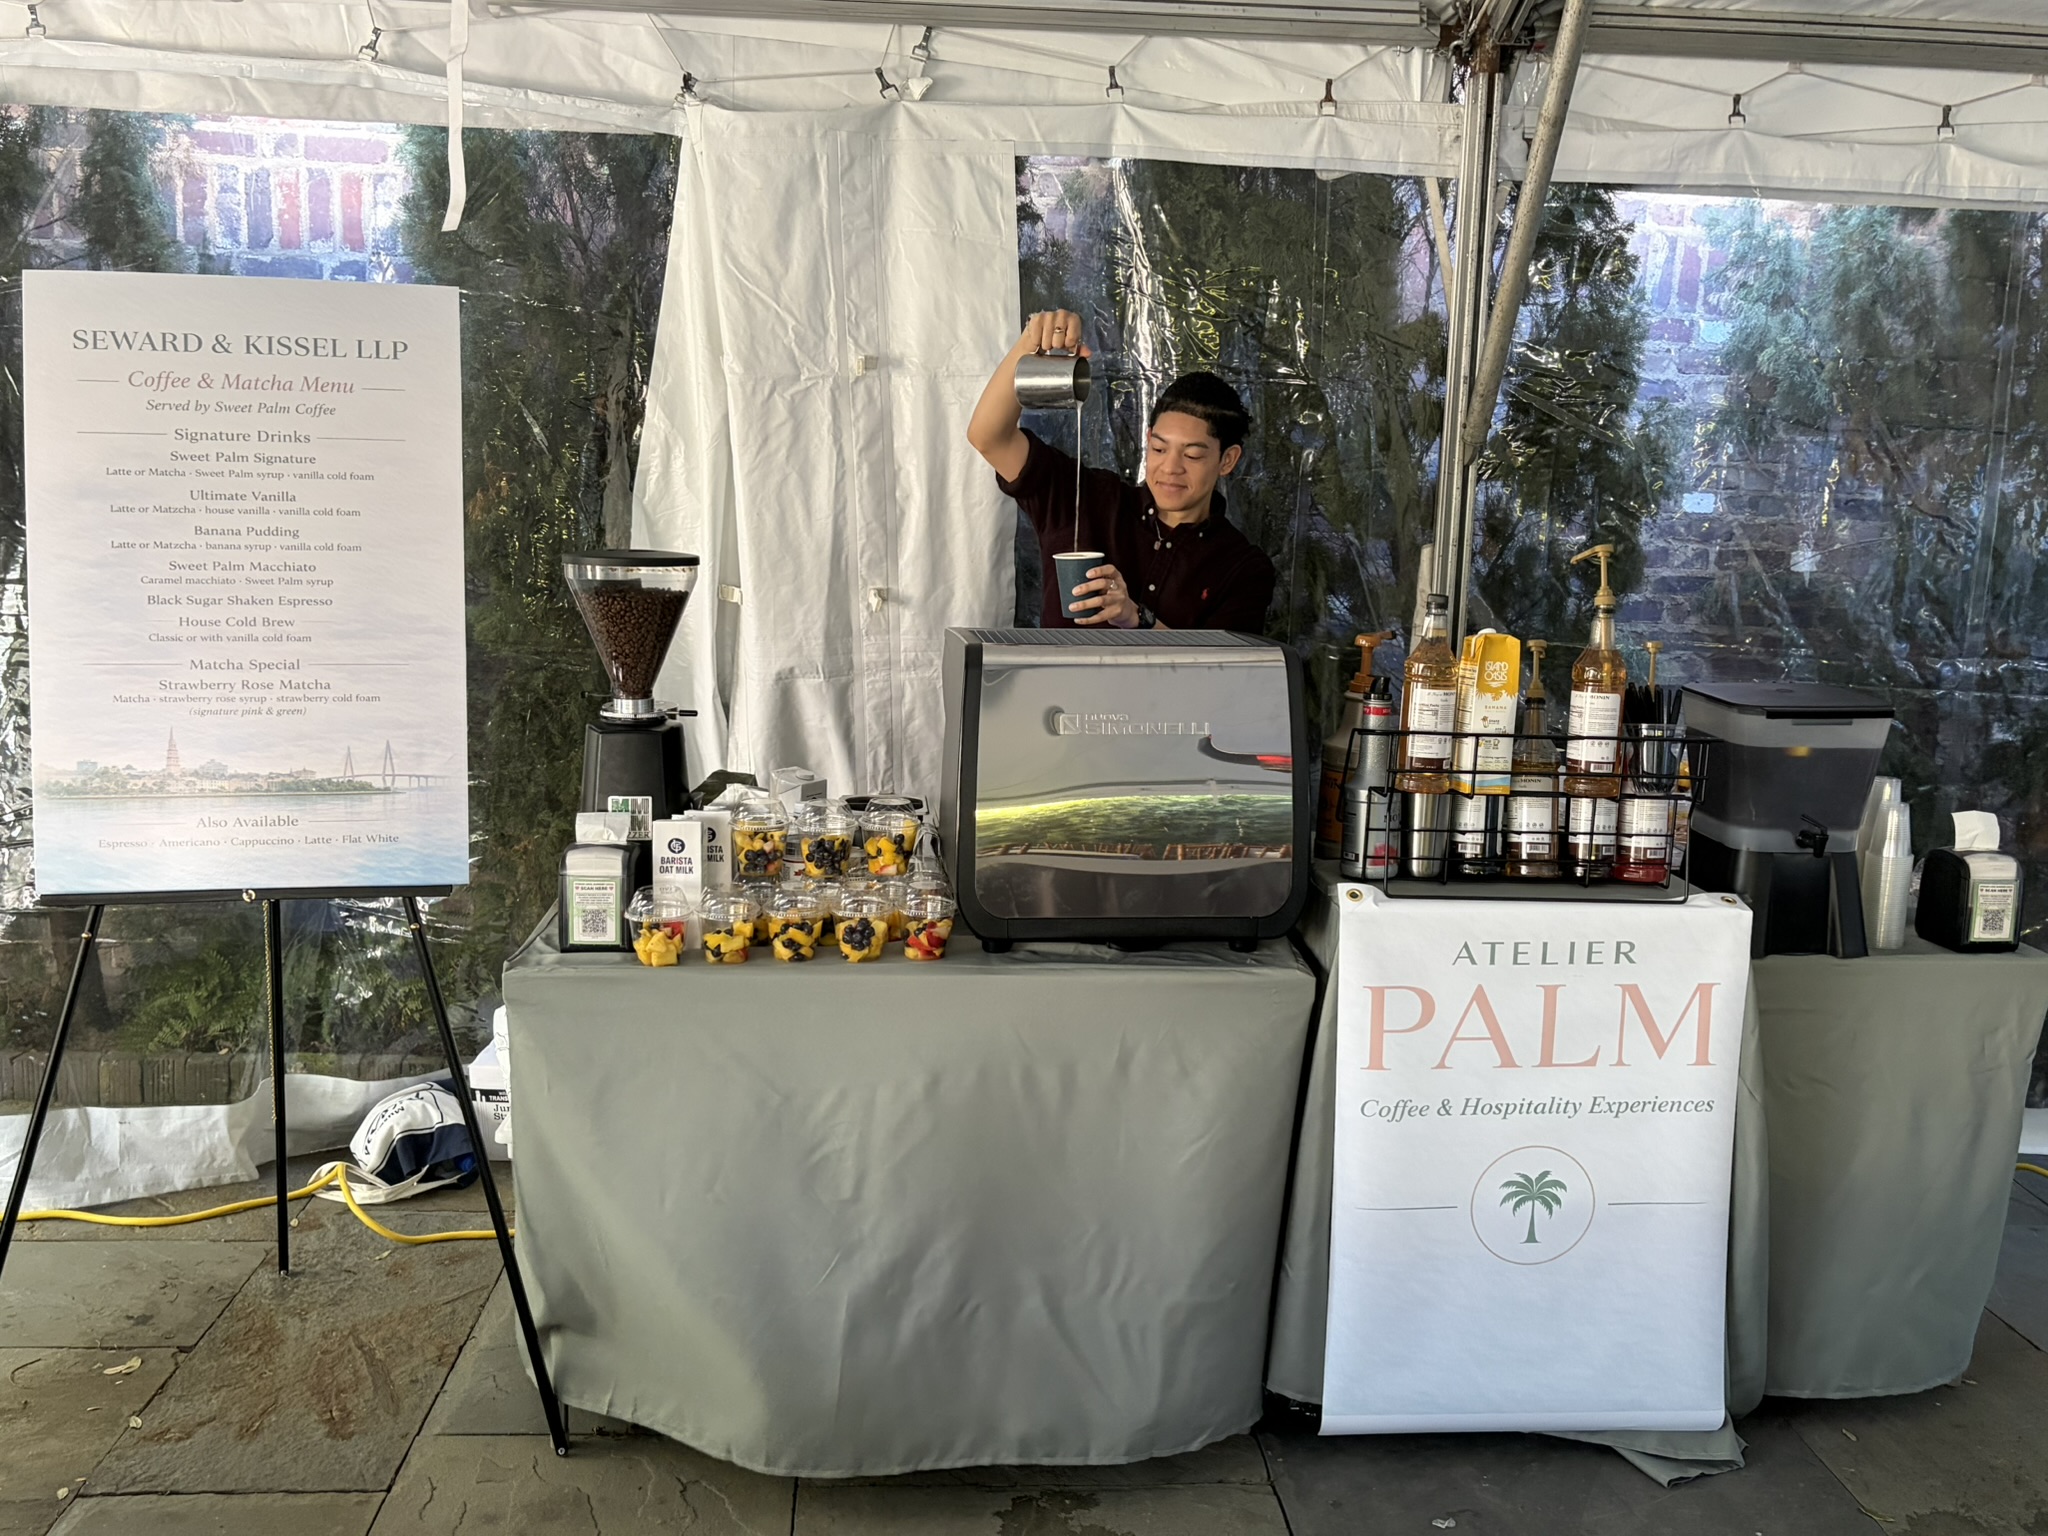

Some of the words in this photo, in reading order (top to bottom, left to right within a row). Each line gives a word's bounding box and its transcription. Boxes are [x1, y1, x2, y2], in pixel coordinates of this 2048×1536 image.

[73, 329, 203, 353] SEWARD
[211, 333, 232, 354] &
[245, 335, 347, 358] KISSEL
[357, 339, 408, 360] LLP
[128, 370, 191, 392] Coffee
[196, 372, 214, 389] &
[221, 373, 293, 391] Matcha
[299, 375, 354, 394] Menu
[145, 398, 191, 411] Served
[194, 399, 211, 415] by
[214, 400, 253, 413] Sweet
[257, 401, 290, 414] Palm
[295, 402, 336, 418] Coffee
[174, 427, 251, 444] Signature
[257, 430, 311, 443] Drinks
[169, 450, 210, 462] Sweet
[215, 451, 249, 463] Palm
[253, 452, 316, 465] Signature
[105, 467, 132, 476] Latte
[148, 467, 186, 477] Matcha
[194, 468, 225, 478] Sweet
[228, 469, 253, 478] Palm
[256, 472, 285, 481] syrup
[292, 470, 325, 480] vanilla
[326, 471, 347, 480] cold
[349, 471, 374, 481] foam
[189, 489, 247, 501] Ultimate
[251, 490, 296, 502] Vanilla
[110, 504, 136, 513] Latte
[204, 505, 235, 515] house
[237, 506, 270, 515] vanilla
[278, 506, 311, 516] vanilla
[312, 507, 334, 516] cold
[335, 507, 361, 517] foam
[194, 525, 242, 536] Banana
[246, 525, 300, 539] Pudding
[111, 540, 137, 549] Latte
[205, 541, 242, 550] banana
[243, 543, 272, 553] syrup
[279, 542, 312, 551] vanilla
[313, 542, 334, 551] cold
[336, 542, 362, 552] foam
[168, 560, 208, 571] Sweet
[212, 560, 245, 571] Palm
[249, 560, 317, 572] Macchiato
[140, 575, 182, 584] Caramel
[185, 575, 236, 585] macchiato
[244, 576, 275, 585] Sweet
[277, 576, 303, 586] Palm
[305, 579, 334, 588] syrup
[147, 594, 183, 605] Black
[185, 595, 223, 607] Sugar
[226, 594, 274, 606] Shaken
[278, 595, 333, 608] Espresso
[179, 616, 221, 627] House
[225, 616, 257, 627] Cold
[262, 616, 295, 627] Brew
[148, 632, 184, 642] Classic
[199, 633, 223, 642] with
[225, 633, 259, 642] vanilla
[261, 633, 283, 643] cold
[285, 633, 312, 643] foam
[189, 658, 244, 670] Matcha
[248, 658, 300, 673] Special
[1485, 660, 1509, 671] ISLAND
[1484, 671, 1508, 681] OASIS
[158, 678, 236, 693] Strawberry
[241, 679, 274, 690] Rose
[279, 678, 331, 690] Matcha
[112, 694, 150, 703] Matcha
[159, 693, 213, 705] strawberry
[239, 696, 267, 705] syrup
[276, 693, 330, 704] strawberry
[331, 693, 353, 703] cold
[355, 693, 381, 702] foam
[188, 707, 239, 718] (signature
[240, 706, 263, 717] pink
[265, 706, 274, 716] &
[275, 706, 307, 717] green)
[1085, 722, 1211, 735] SIMONELLI
[196, 816, 228, 828] Also
[232, 814, 299, 827] Available
[99, 839, 148, 850] Espresso
[159, 839, 220, 847] Americano
[230, 836, 295, 848] Cappuccino
[304, 835, 332, 845] Latte
[342, 834, 362, 844] Flat
[365, 833, 399, 846] White
[707, 845, 724, 854] ISTA
[660, 856, 693, 866] BARISTA
[659, 866, 673, 875] OAT
[675, 866, 694, 875] MILK
[1452, 941, 1637, 966] ATELIER
[1360, 982, 1722, 1071] PALM
[1360, 1099, 1430, 1124] Coffee
[1437, 1099, 1453, 1117] &
[1460, 1097, 1583, 1120] Hospitality
[1588, 1096, 1715, 1118] Experiences
